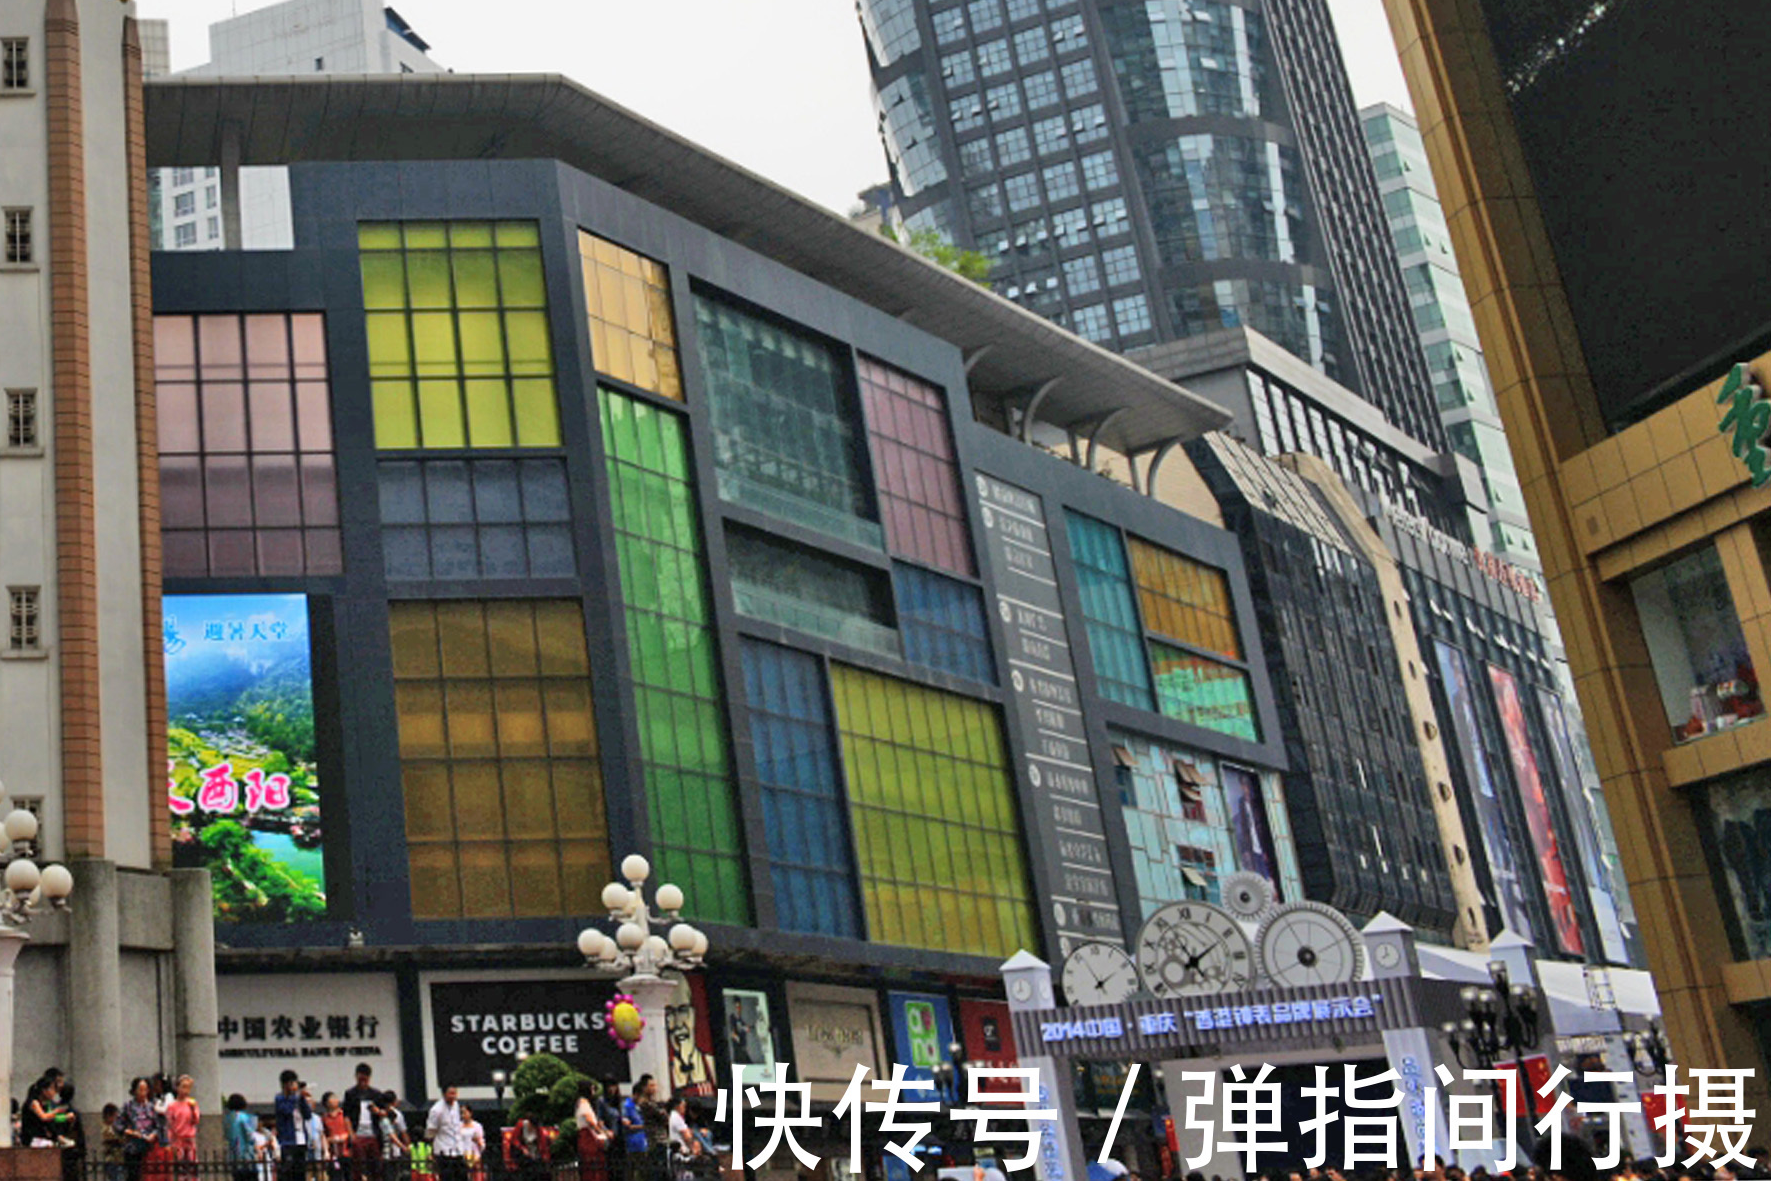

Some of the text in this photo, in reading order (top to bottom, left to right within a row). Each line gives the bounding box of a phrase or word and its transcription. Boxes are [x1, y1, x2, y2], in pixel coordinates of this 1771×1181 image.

[203, 621, 289, 642] 避暑天堂
[217, 1015, 380, 1042] 中国农业银行
[450, 1012, 606, 1033] STARBUCKS
[301, 1046, 331, 1058] BANK
[480, 1035, 579, 1055] COFFEE
